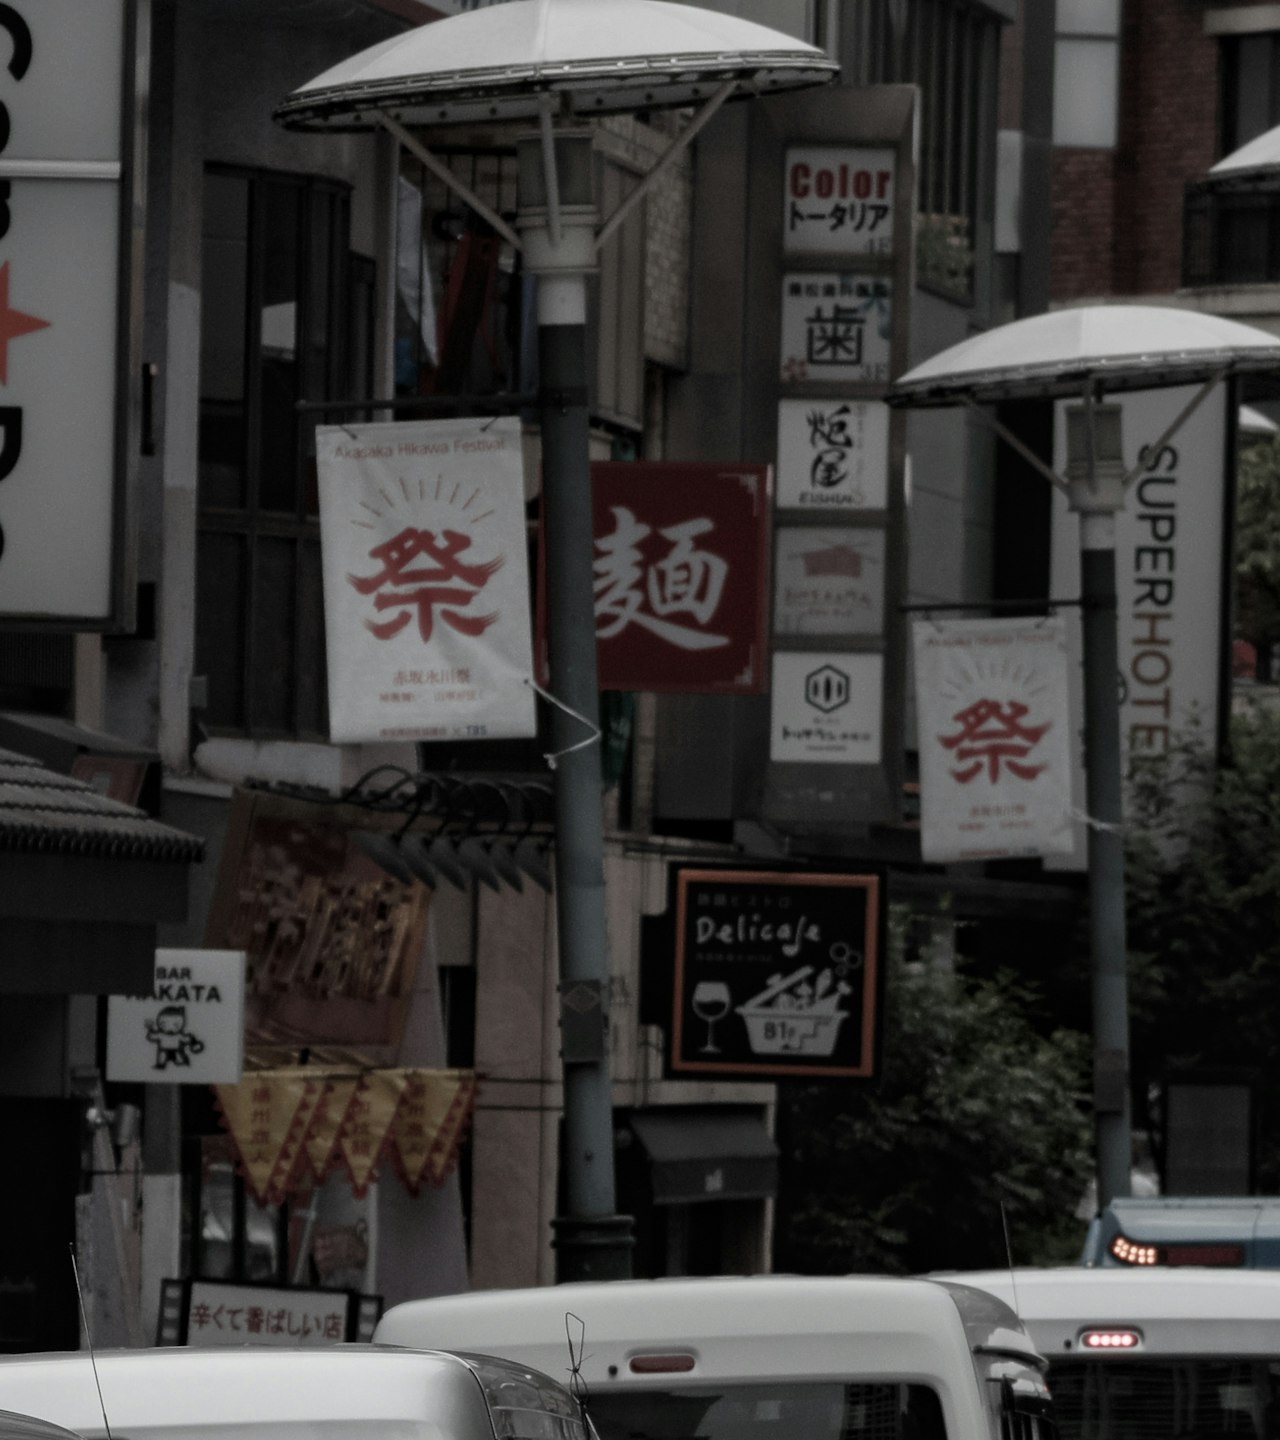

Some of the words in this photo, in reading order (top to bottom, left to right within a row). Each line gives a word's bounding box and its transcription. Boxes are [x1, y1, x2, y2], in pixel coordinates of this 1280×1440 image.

[790, 163, 891, 199] Color
[790, 203, 889, 231] トータリア
[805, 304, 866, 365] 歯
[346, 526, 504, 643] 祭
[937, 699, 1052, 785] 祭
[156, 967, 192, 980] BAR
